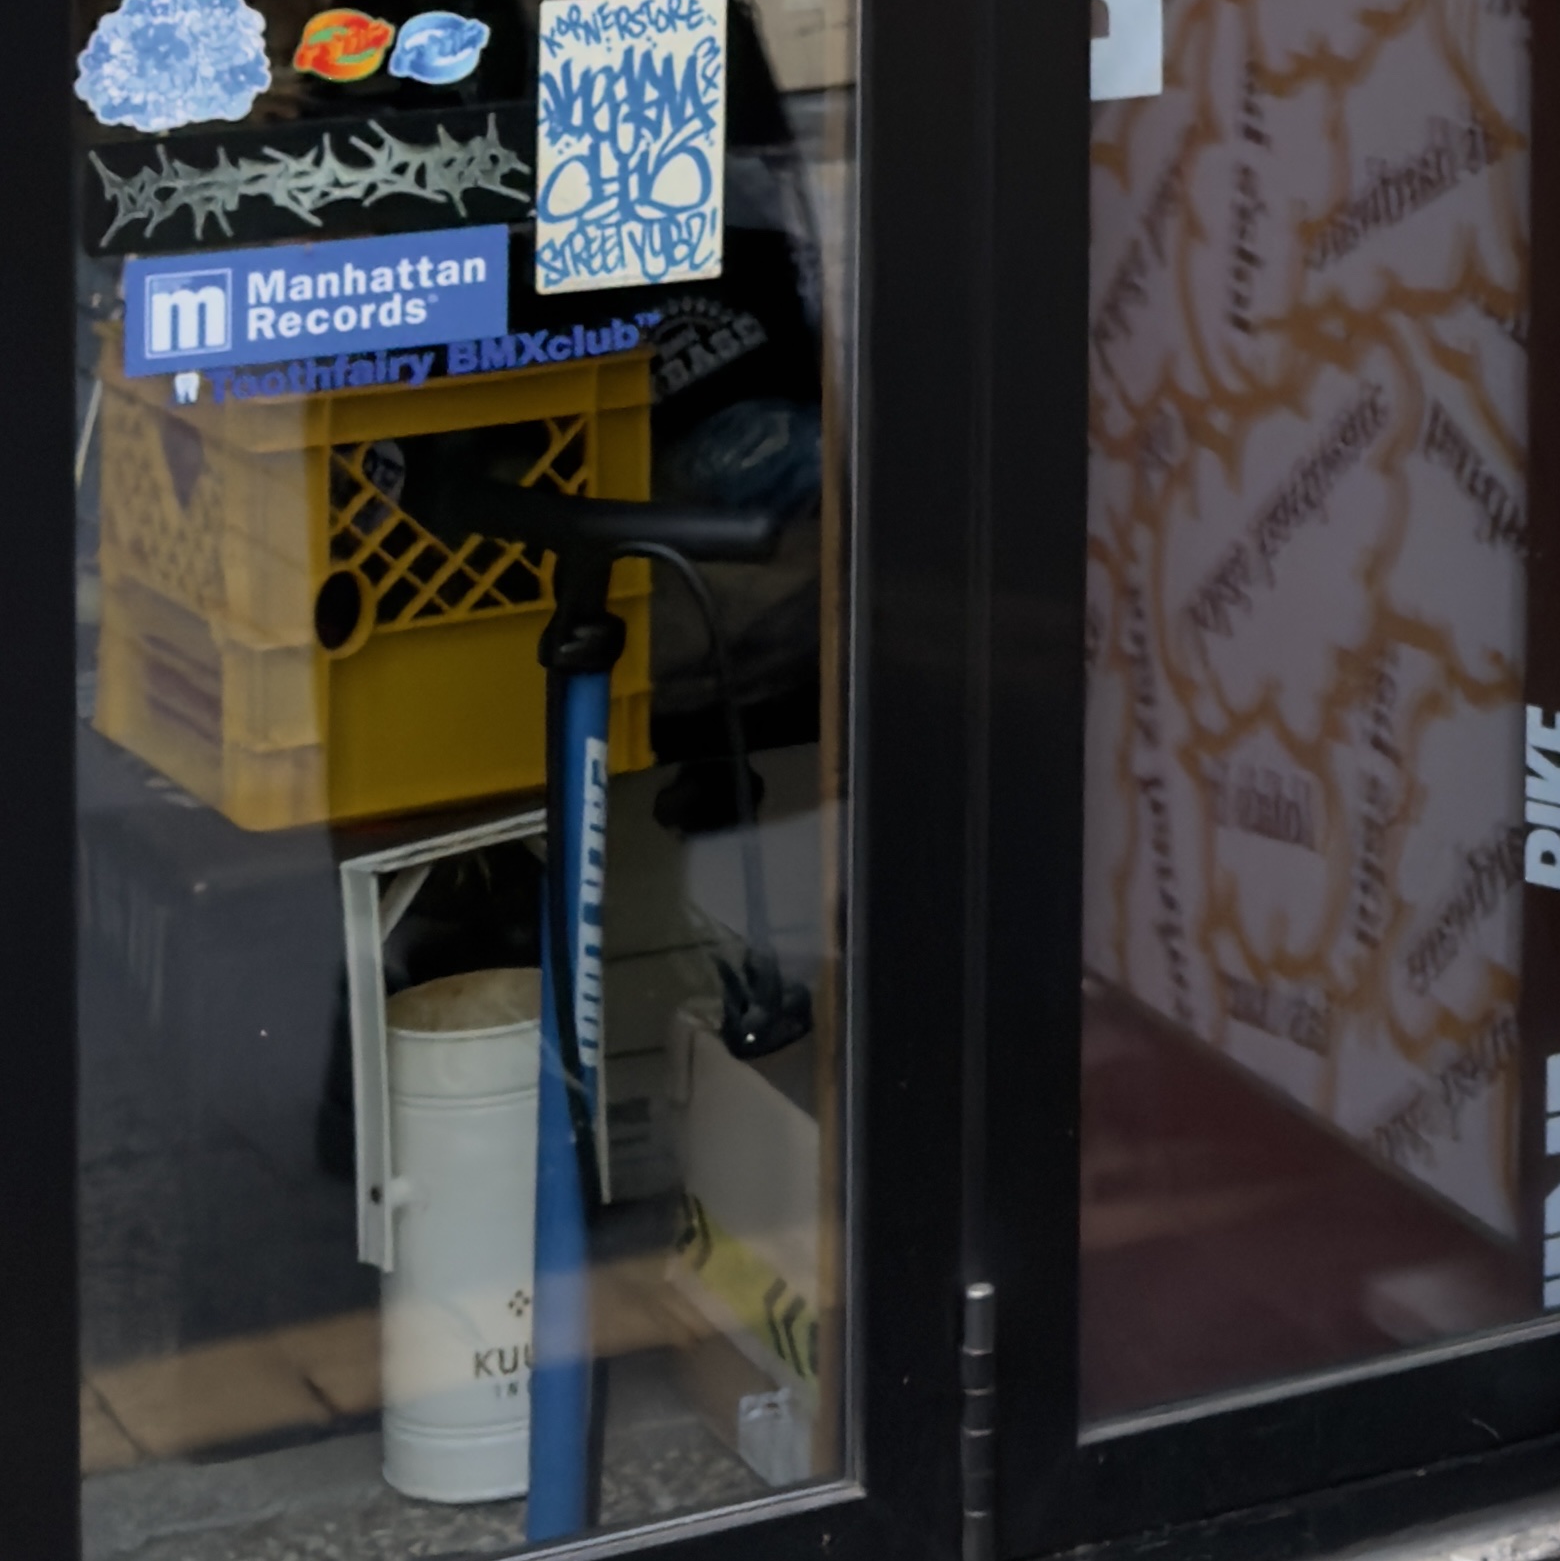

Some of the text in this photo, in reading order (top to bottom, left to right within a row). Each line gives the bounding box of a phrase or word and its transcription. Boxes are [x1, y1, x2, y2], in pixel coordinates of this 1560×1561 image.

[247, 254, 487, 307] Manhattan
[248, 296, 428, 341] Records
[209, 349, 437, 405] Toothfairy
